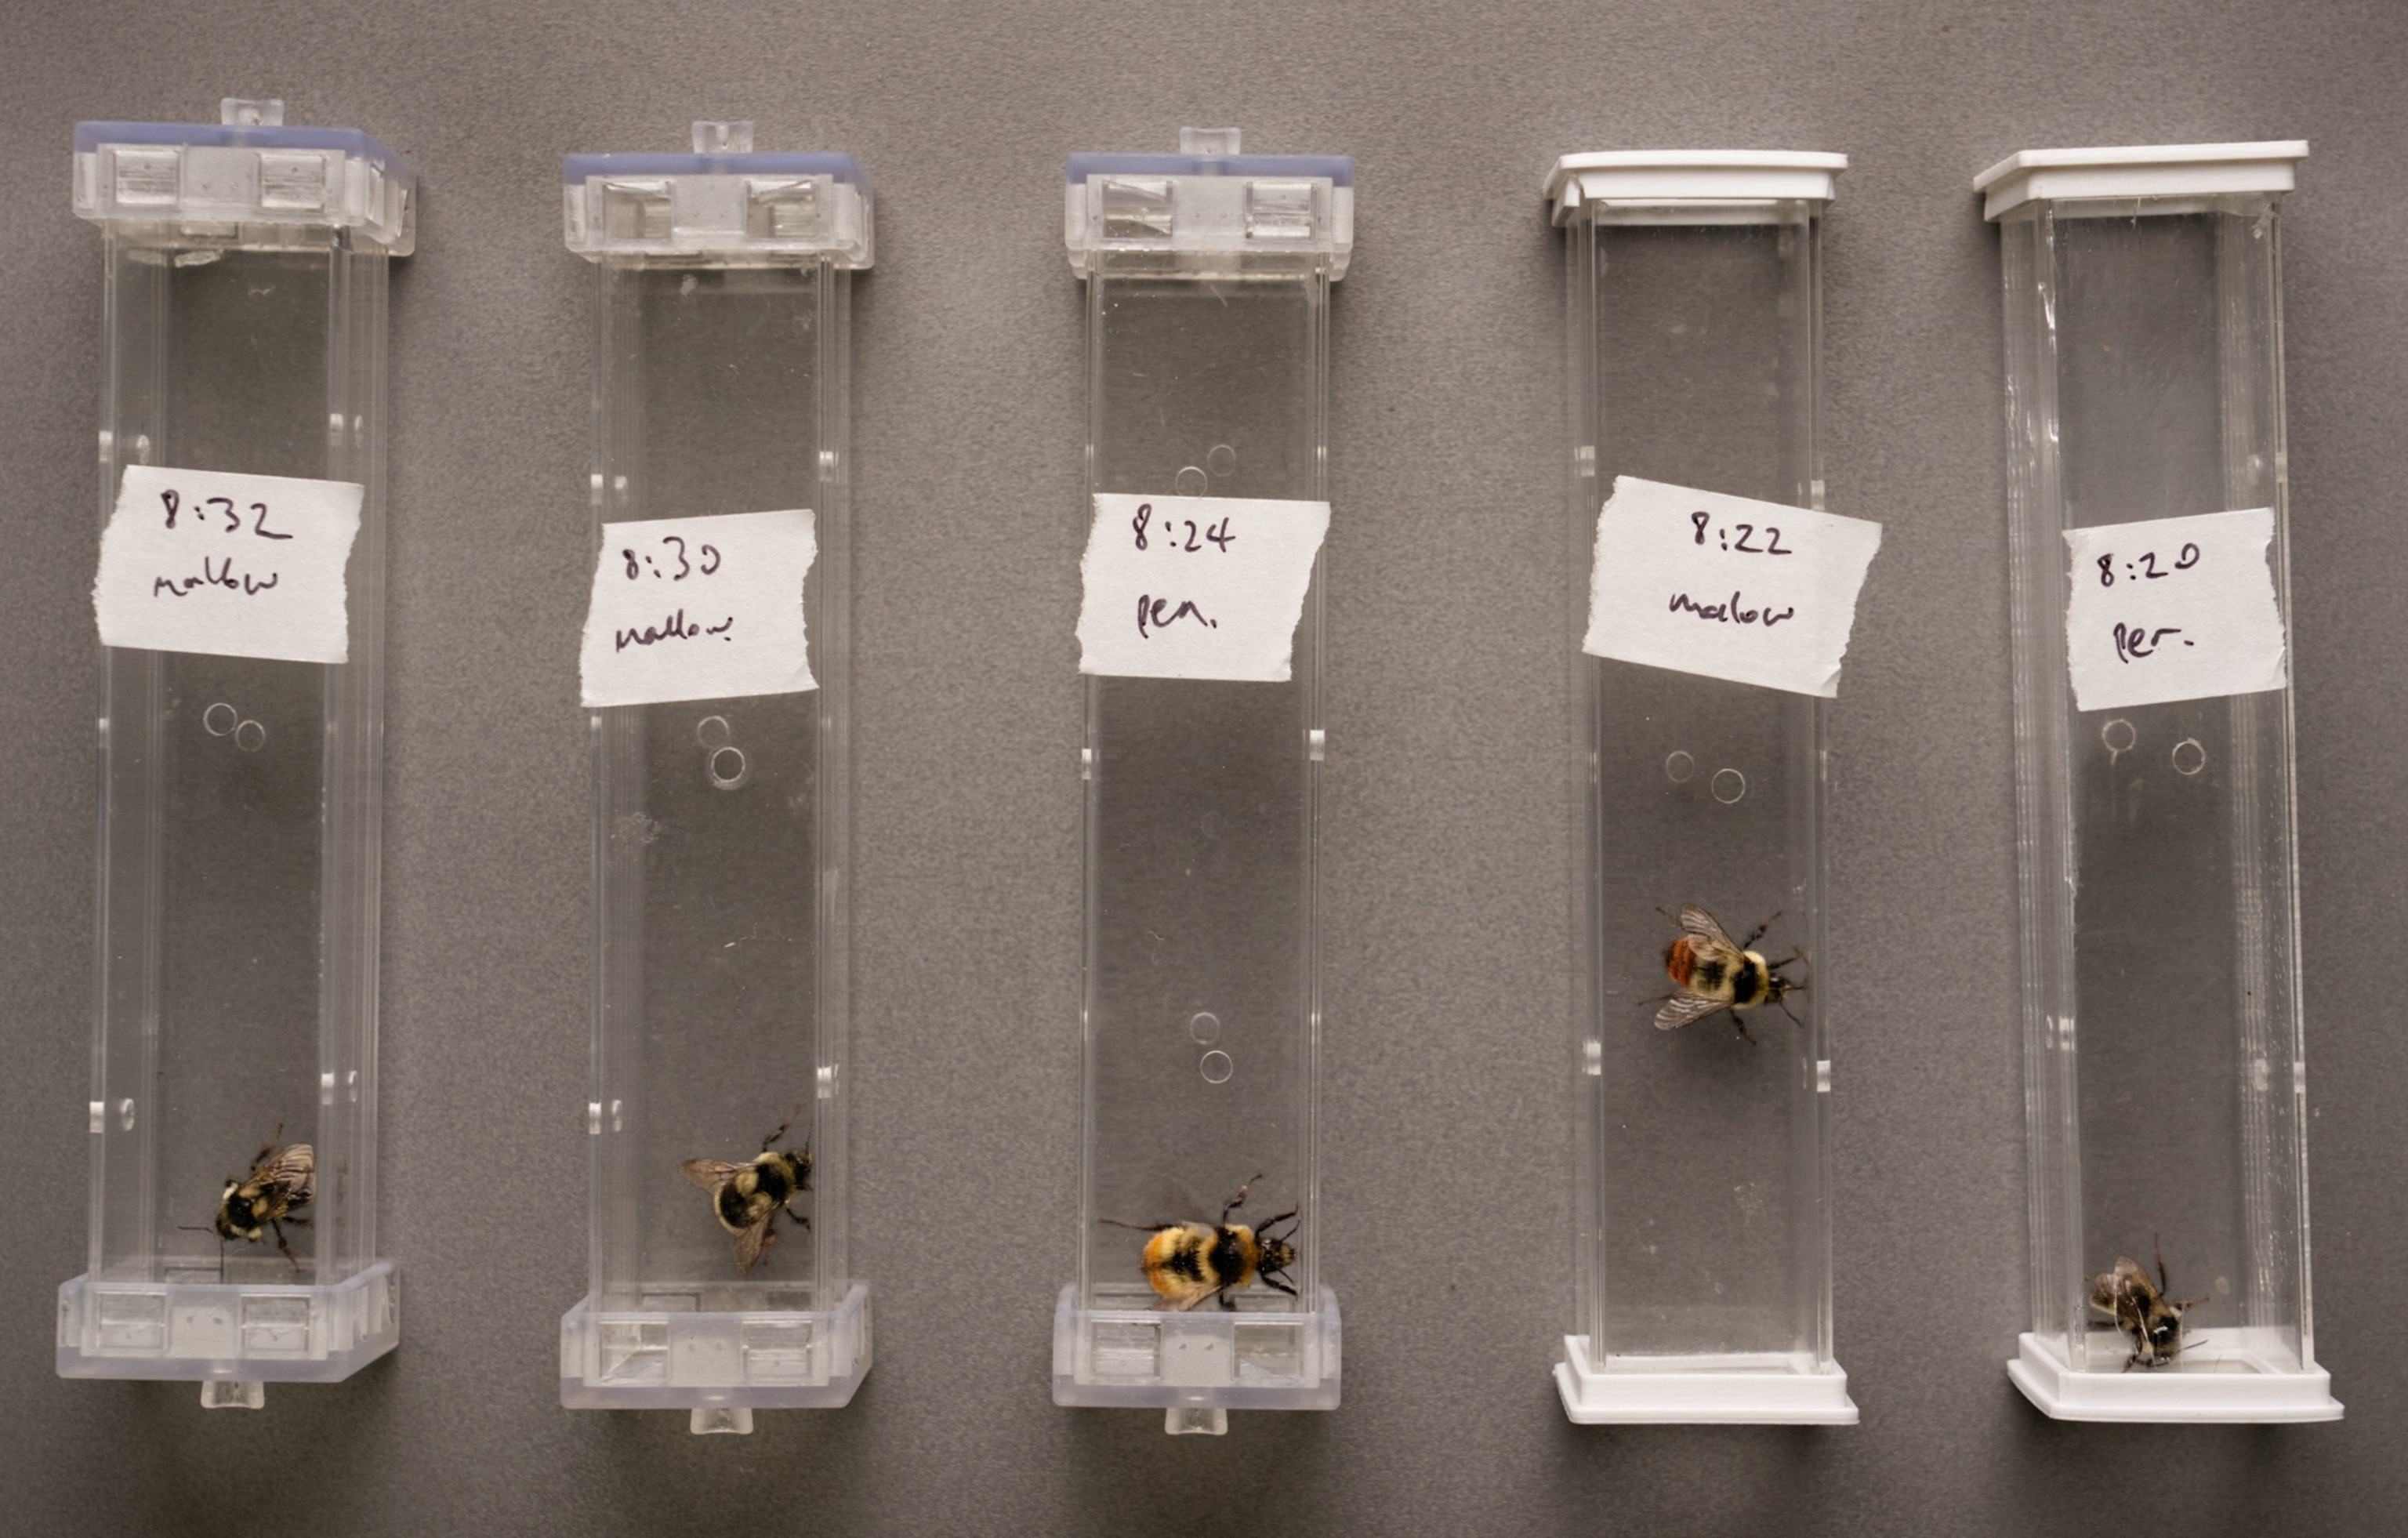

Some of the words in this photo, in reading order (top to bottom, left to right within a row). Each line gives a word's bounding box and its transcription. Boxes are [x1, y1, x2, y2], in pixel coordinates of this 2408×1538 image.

[160, 489, 294, 540] 8:32
[1132, 502, 1237, 553] 8:24
[1690, 510, 1793, 556] 8:22
[154, 556, 278, 597] mallow
[622, 535, 723, 581] 8:30
[2097, 542, 2201, 587] 8:20
